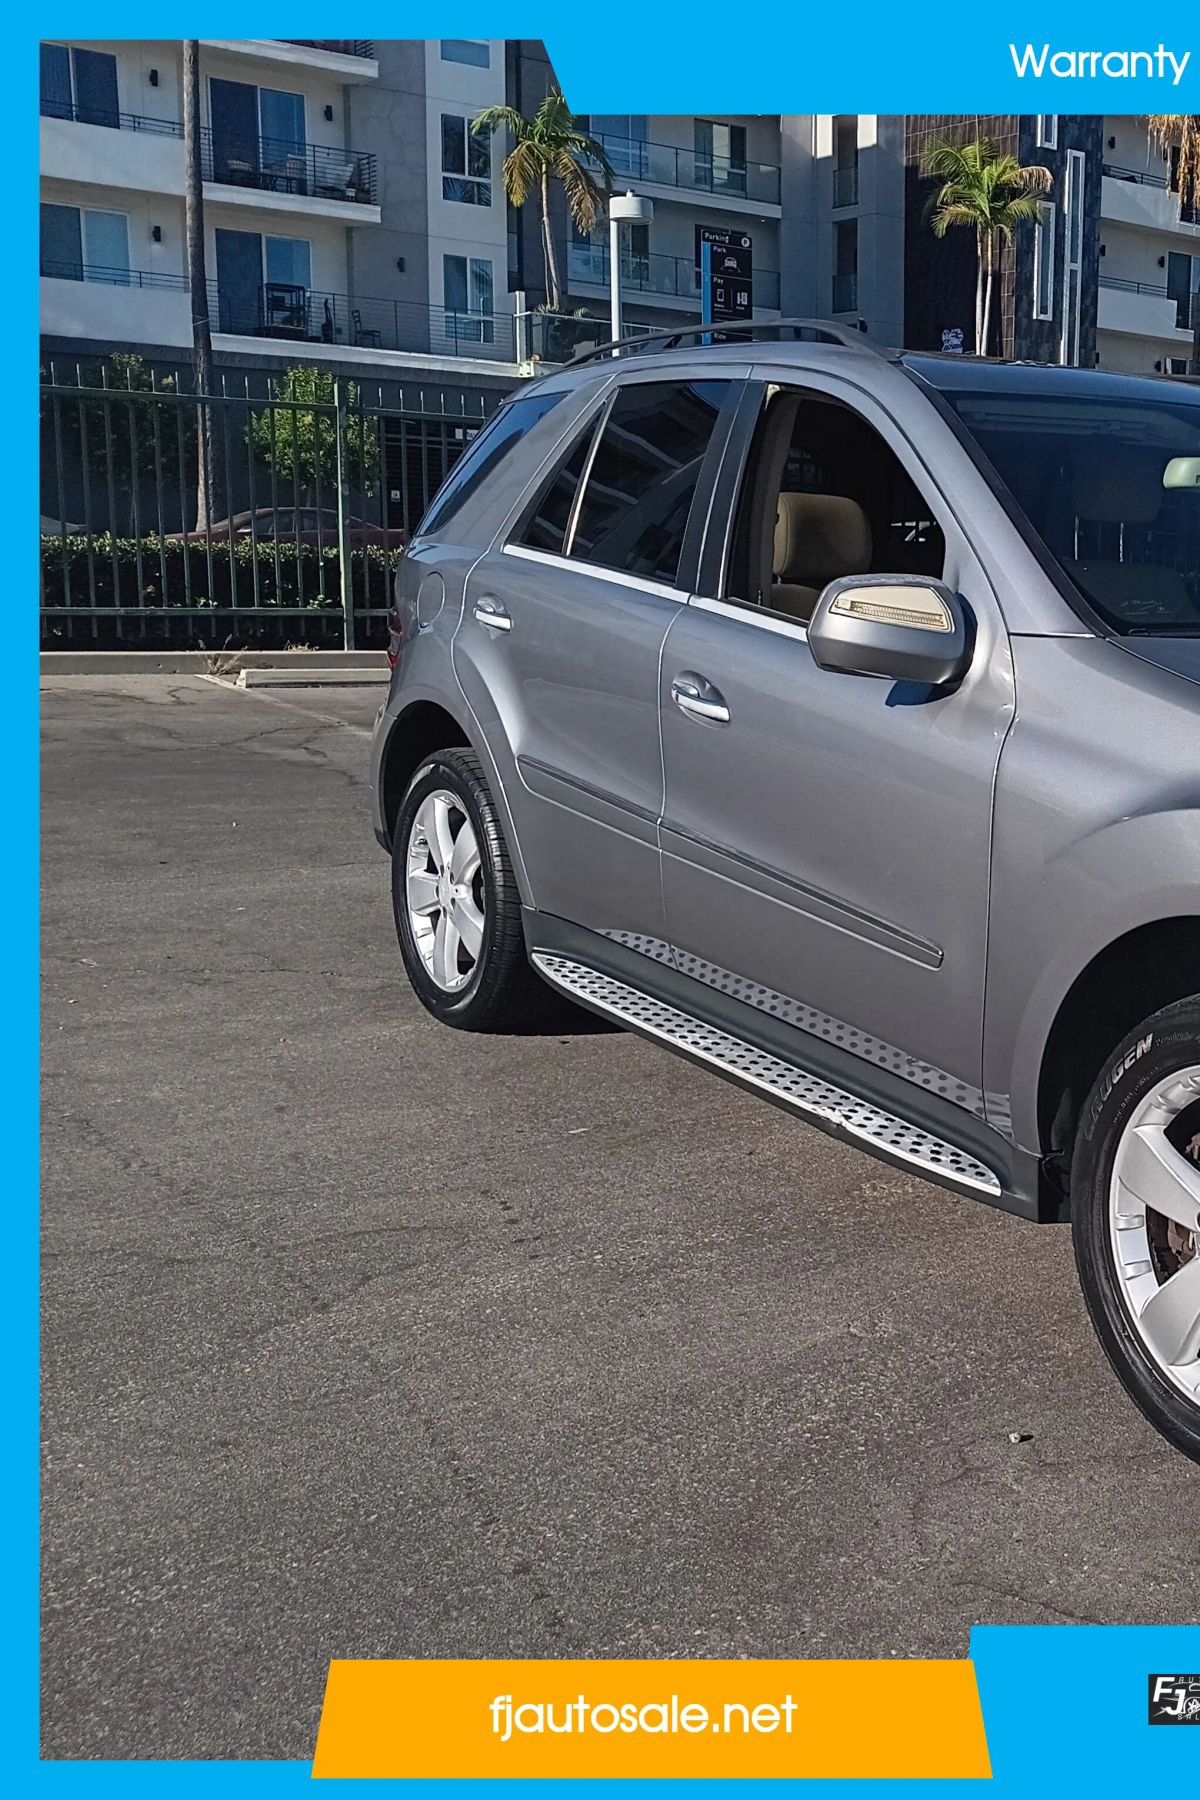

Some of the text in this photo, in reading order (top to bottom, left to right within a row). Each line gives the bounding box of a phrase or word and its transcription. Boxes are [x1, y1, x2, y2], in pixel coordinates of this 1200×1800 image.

[704, 232, 730, 244] Parking
[713, 245, 727, 253] Park
[713, 276, 724, 285] Pay
